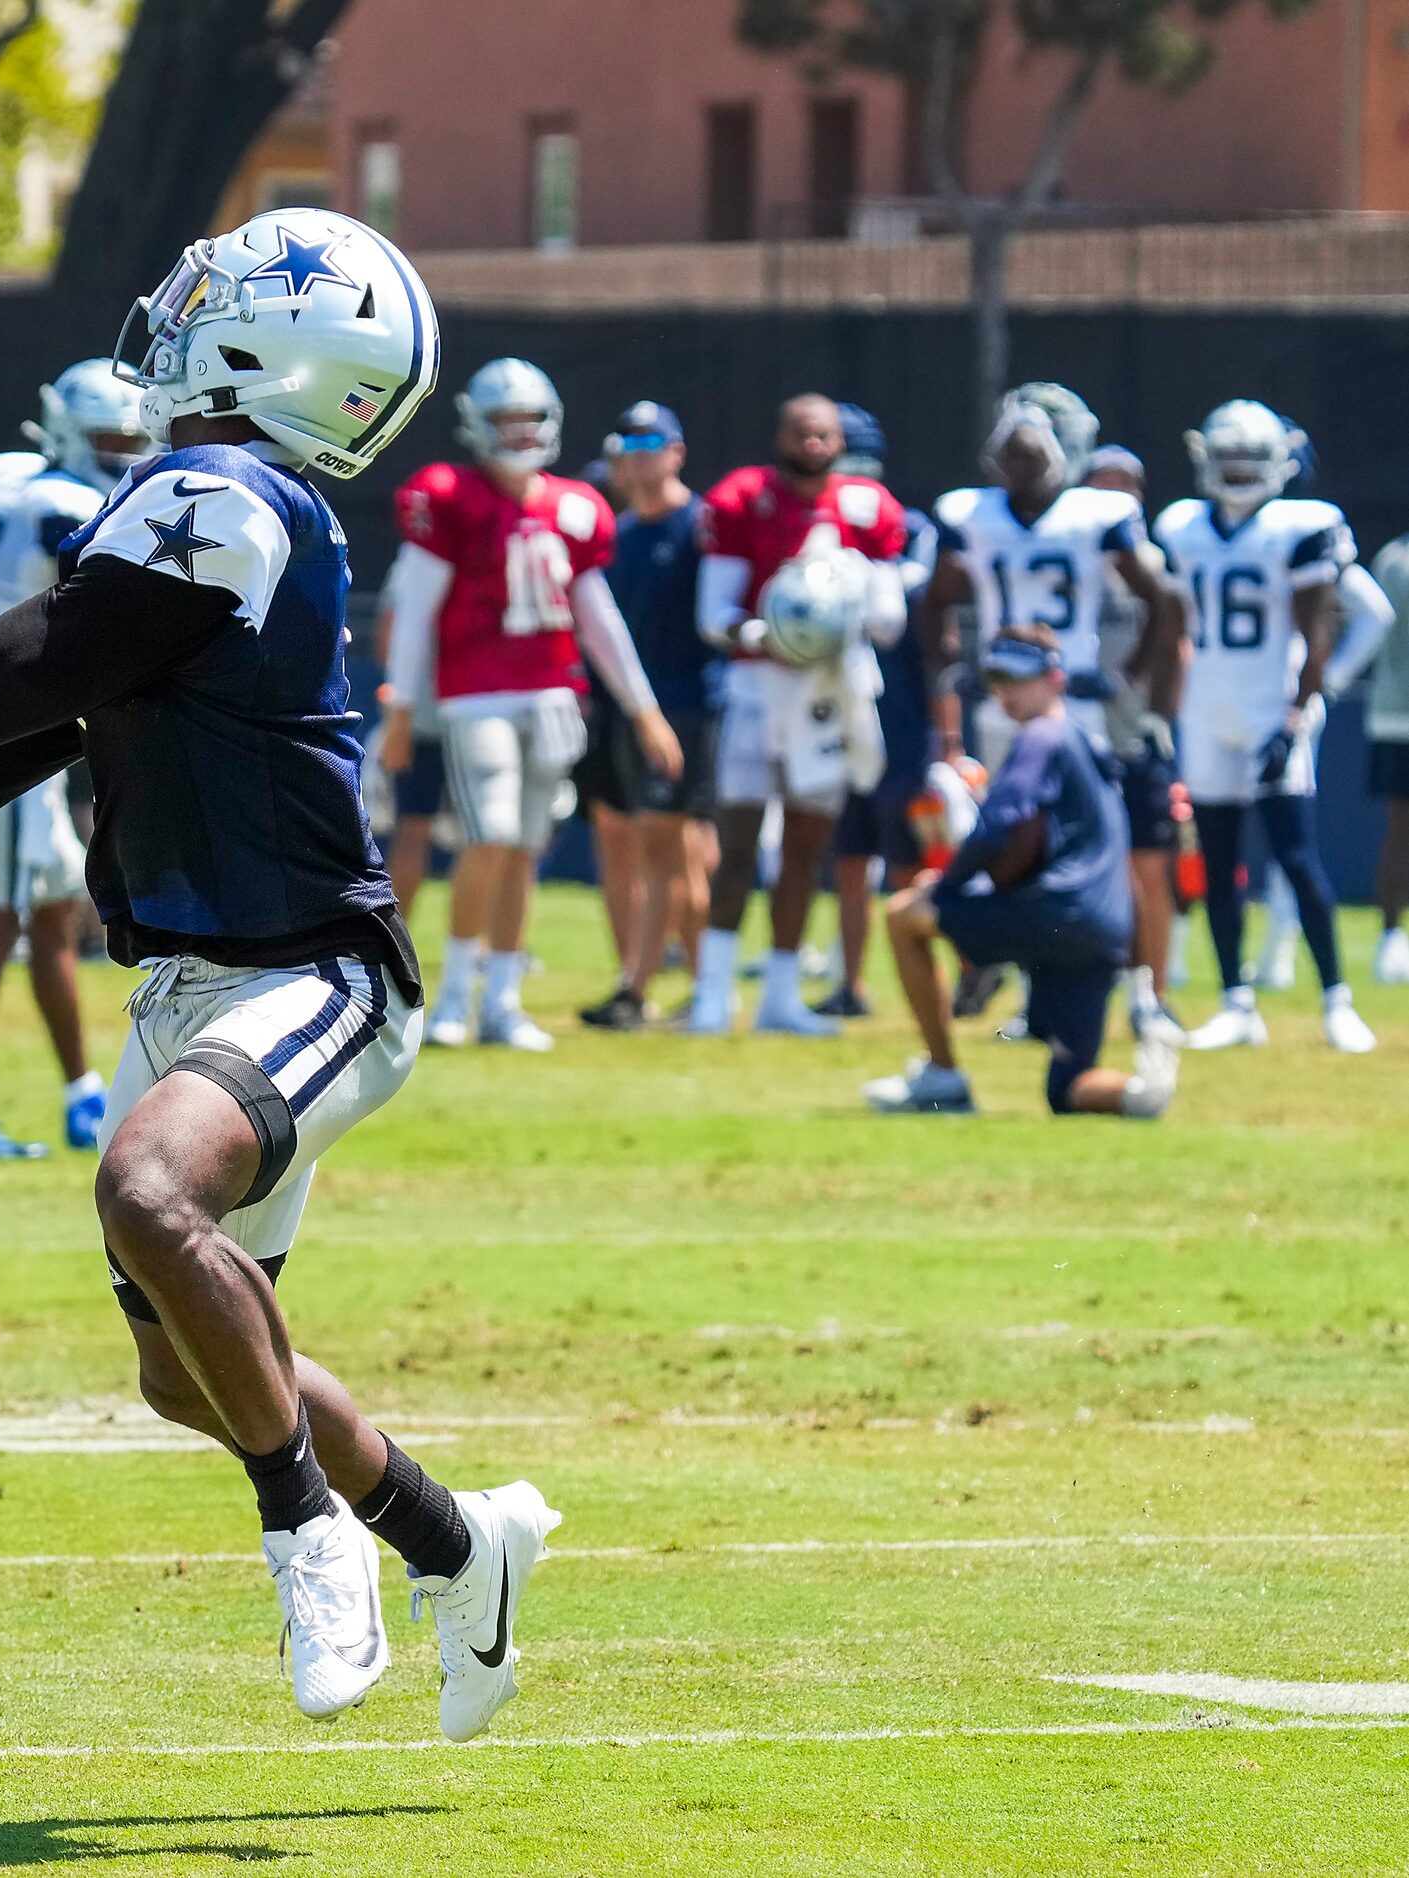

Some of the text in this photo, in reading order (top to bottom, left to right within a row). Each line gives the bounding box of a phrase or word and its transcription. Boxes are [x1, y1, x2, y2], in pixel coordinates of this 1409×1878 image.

[502, 529, 575, 636] 10
[992, 550, 1076, 630] 13
[1192, 566, 1266, 650] 16
